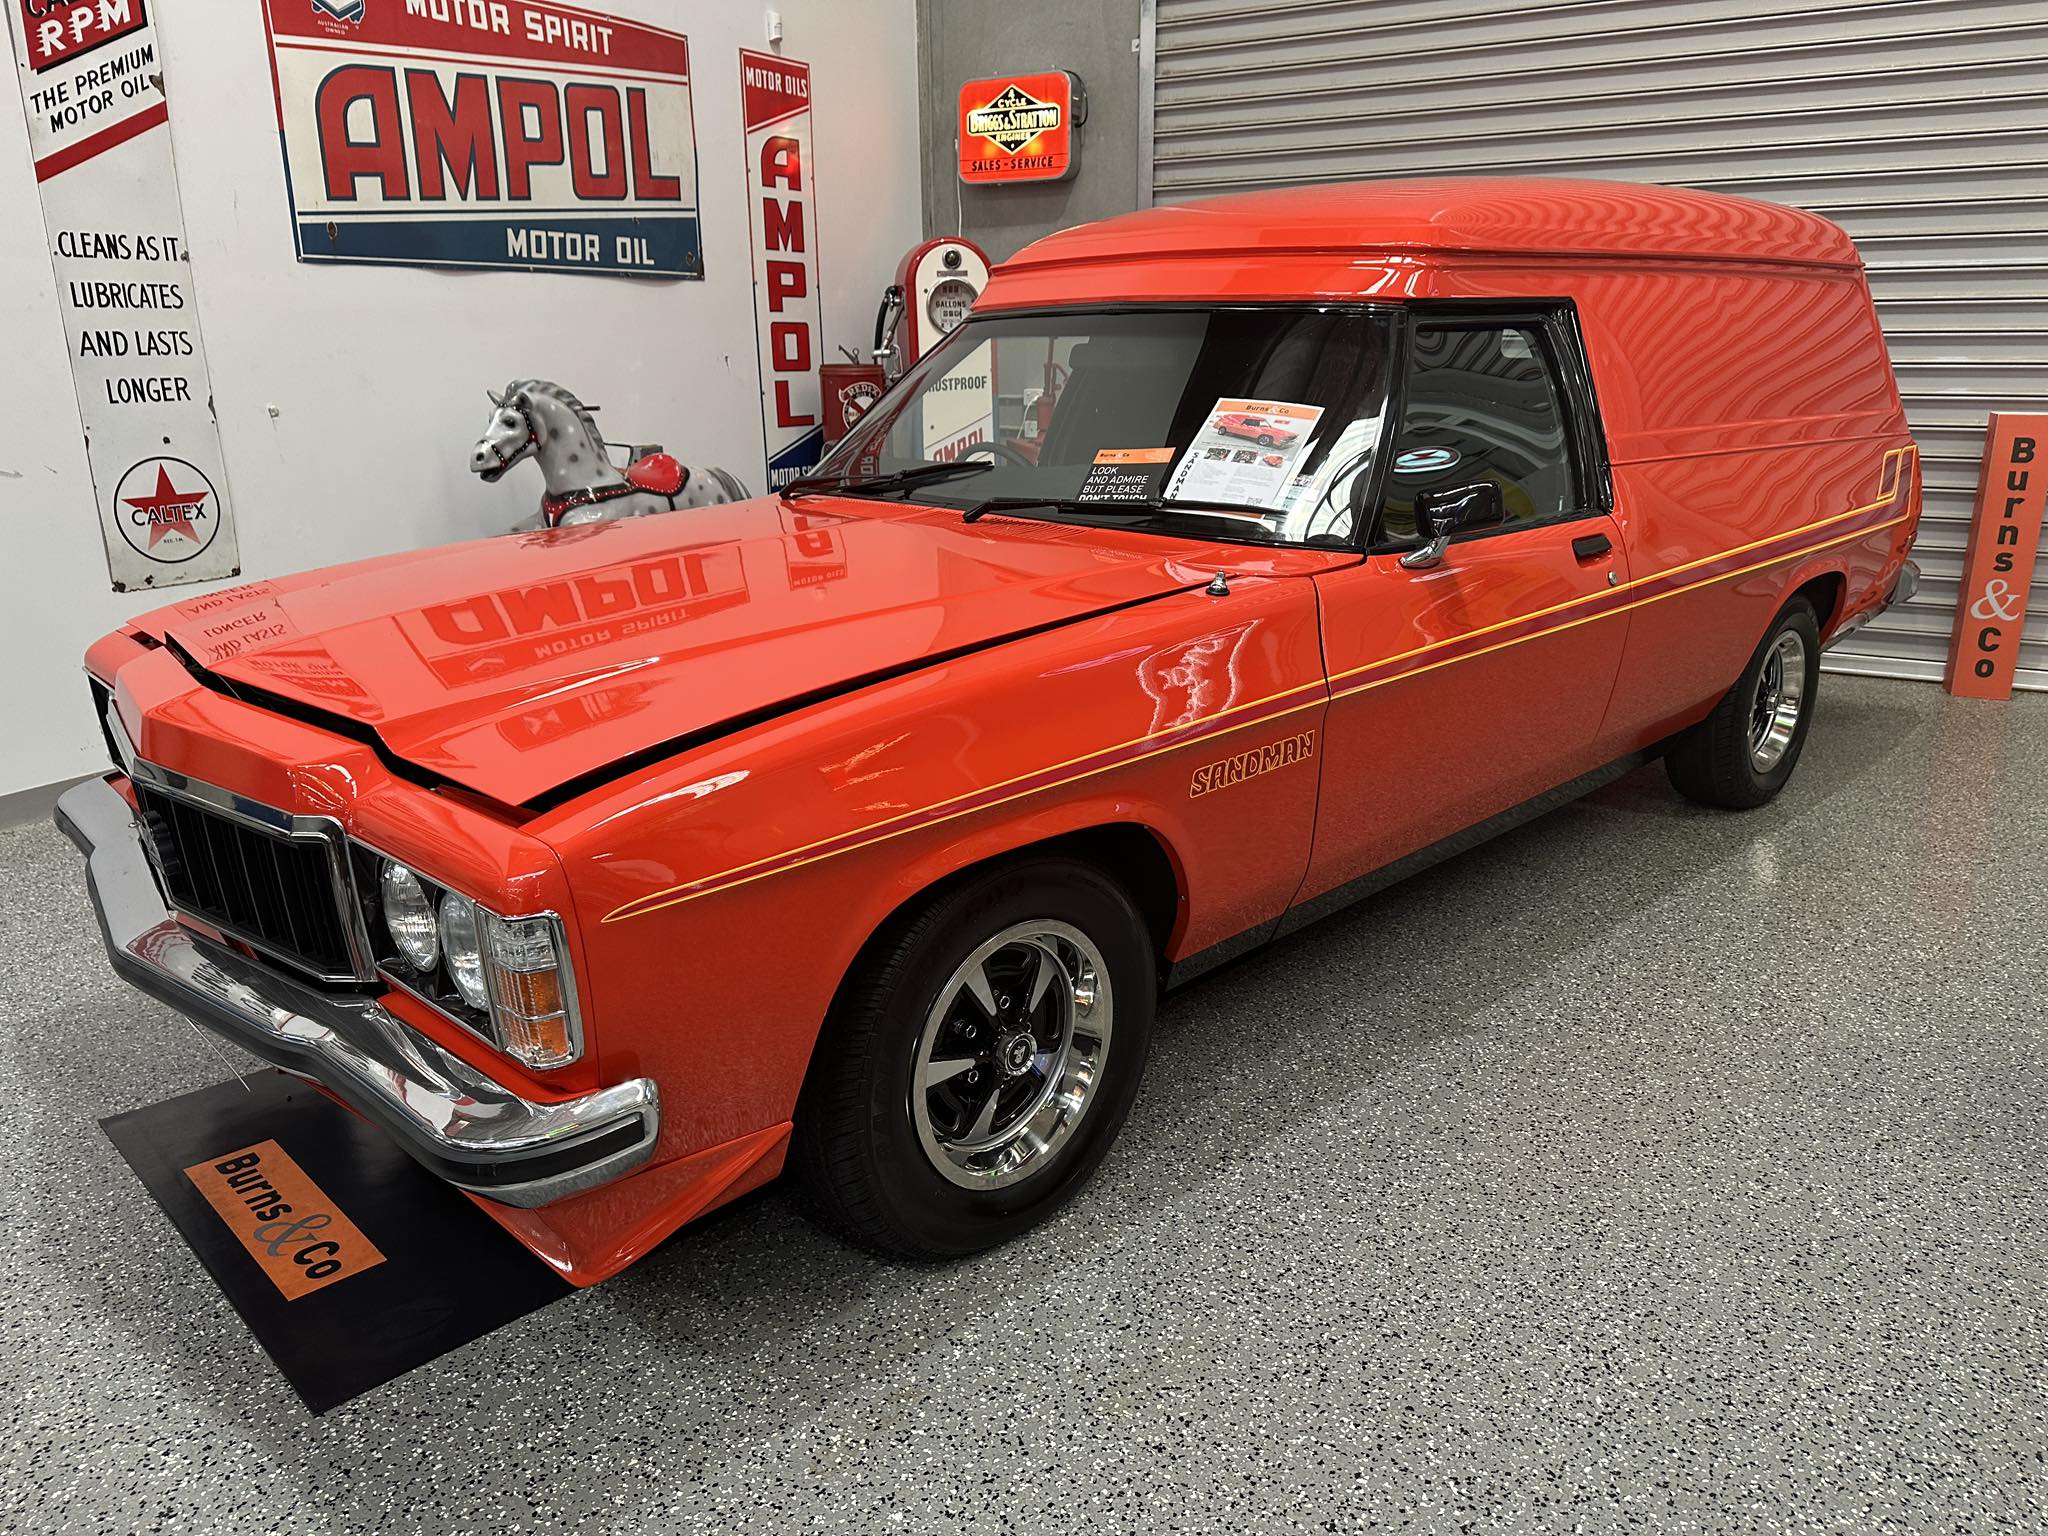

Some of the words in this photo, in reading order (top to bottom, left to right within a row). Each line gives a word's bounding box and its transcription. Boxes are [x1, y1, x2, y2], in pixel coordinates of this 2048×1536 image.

[36, 0, 131, 57] RPM
[317, 20, 349, 30] AUSTRALIAN
[406, 0, 510, 35] MOTOR
[523, 9, 613, 55] SPIRIT
[30, 82, 69, 113] THE
[75, 44, 154, 95] PREMIUM
[746, 66, 782, 93] MOTOR
[785, 75, 808, 98] OILS
[1007, 88, 1015, 98] 4
[50, 91, 113, 133] MOTOR
[121, 74, 149, 98] OIL
[997, 97, 1027, 108] CYCLE
[315, 64, 681, 201] AMPOL
[972, 160, 1001, 172] SALES
[1011, 156, 1054, 169] SERVICE
[58, 232, 131, 259] CLEANS
[136, 236, 160, 260] AS
[163, 237, 178, 261] IT
[506, 227, 600, 262] MOTOR
[616, 236, 655, 265] OIL
[70, 282, 183, 309] LUBRICATES
[760, 135, 815, 428] AMPOL
[80, 331, 128, 356] AND
[135, 331, 193, 356] LASTS
[106, 377, 191, 404] LONGER
[1083, 485, 1104, 493] BUT
[1105, 485, 1144, 493] PLEASE
[1170, 452, 1199, 500] SANDMAN
[132, 503, 206, 526] CALTEX
[1190, 730, 1315, 798] SANDMAN
